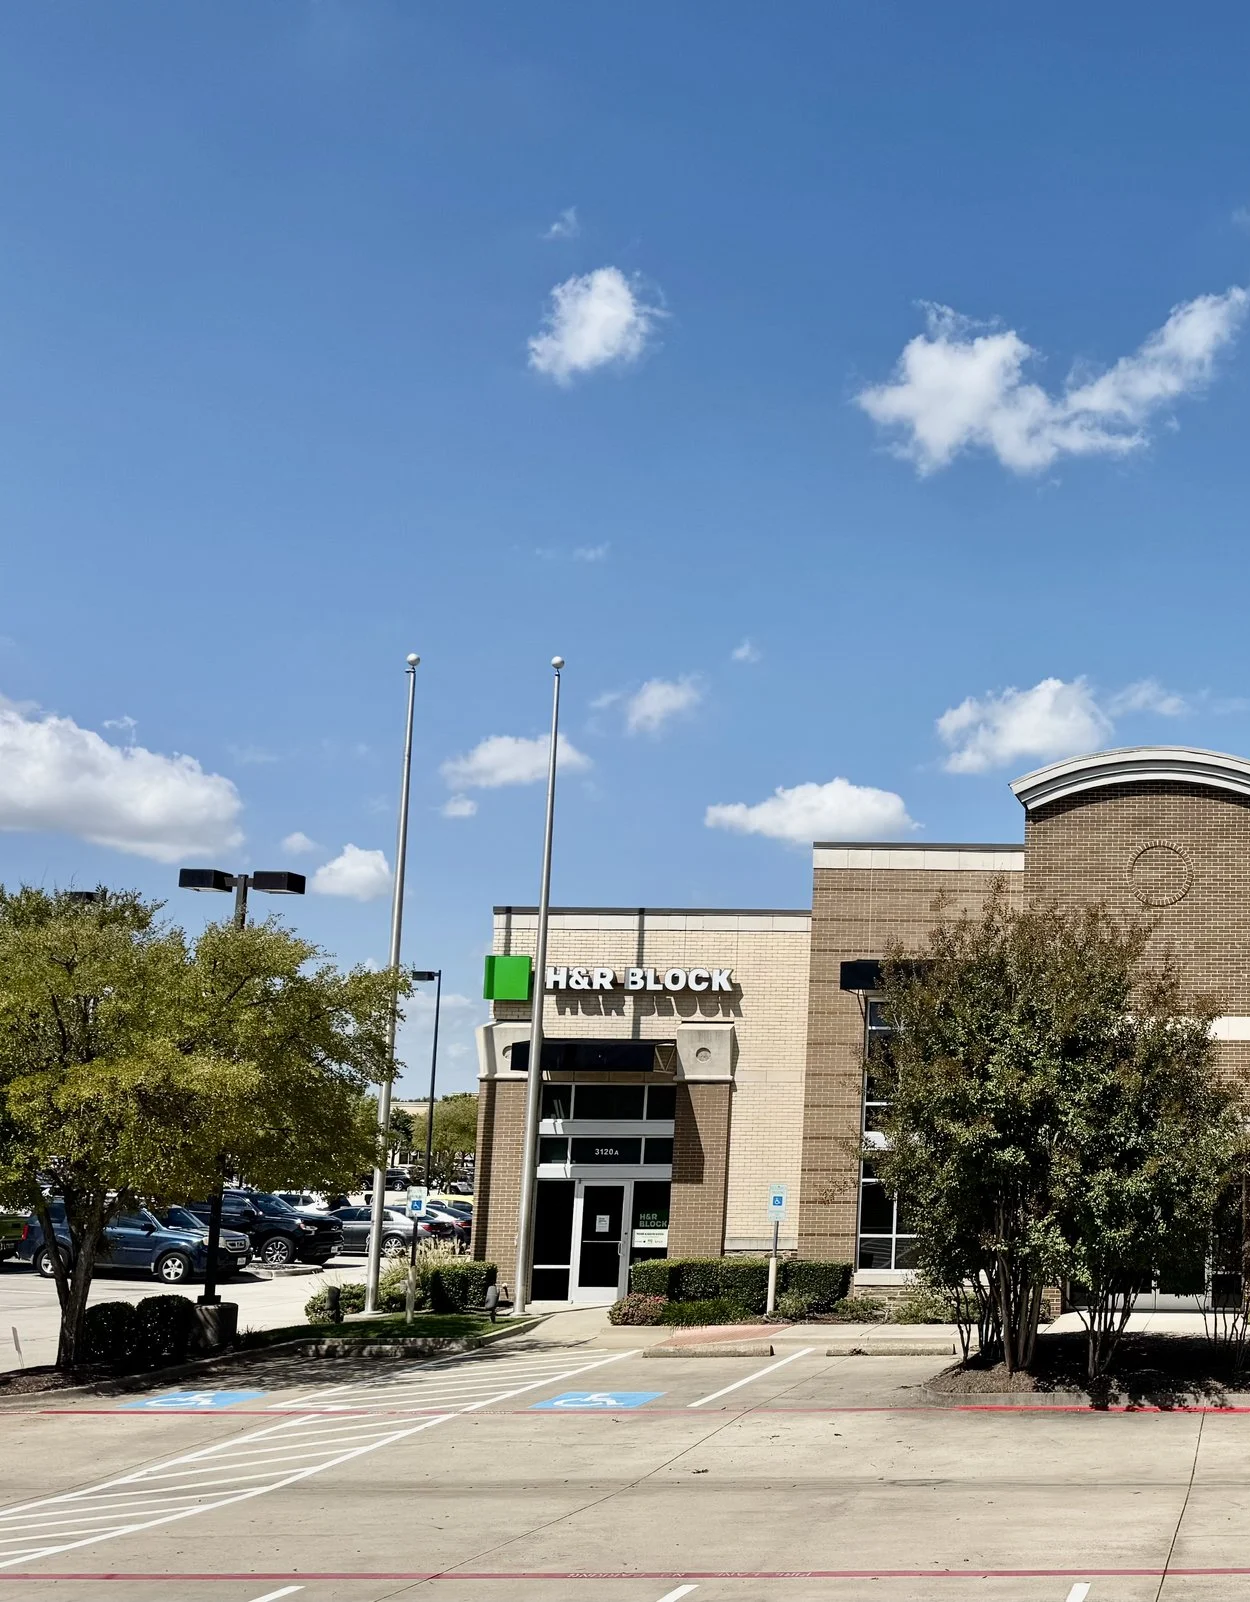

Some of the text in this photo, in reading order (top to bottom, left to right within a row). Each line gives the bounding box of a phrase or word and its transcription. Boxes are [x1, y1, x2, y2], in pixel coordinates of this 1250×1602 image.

[545, 966, 735, 992] H&R BLOCK
[639, 1220, 668, 1228] BLOCK
